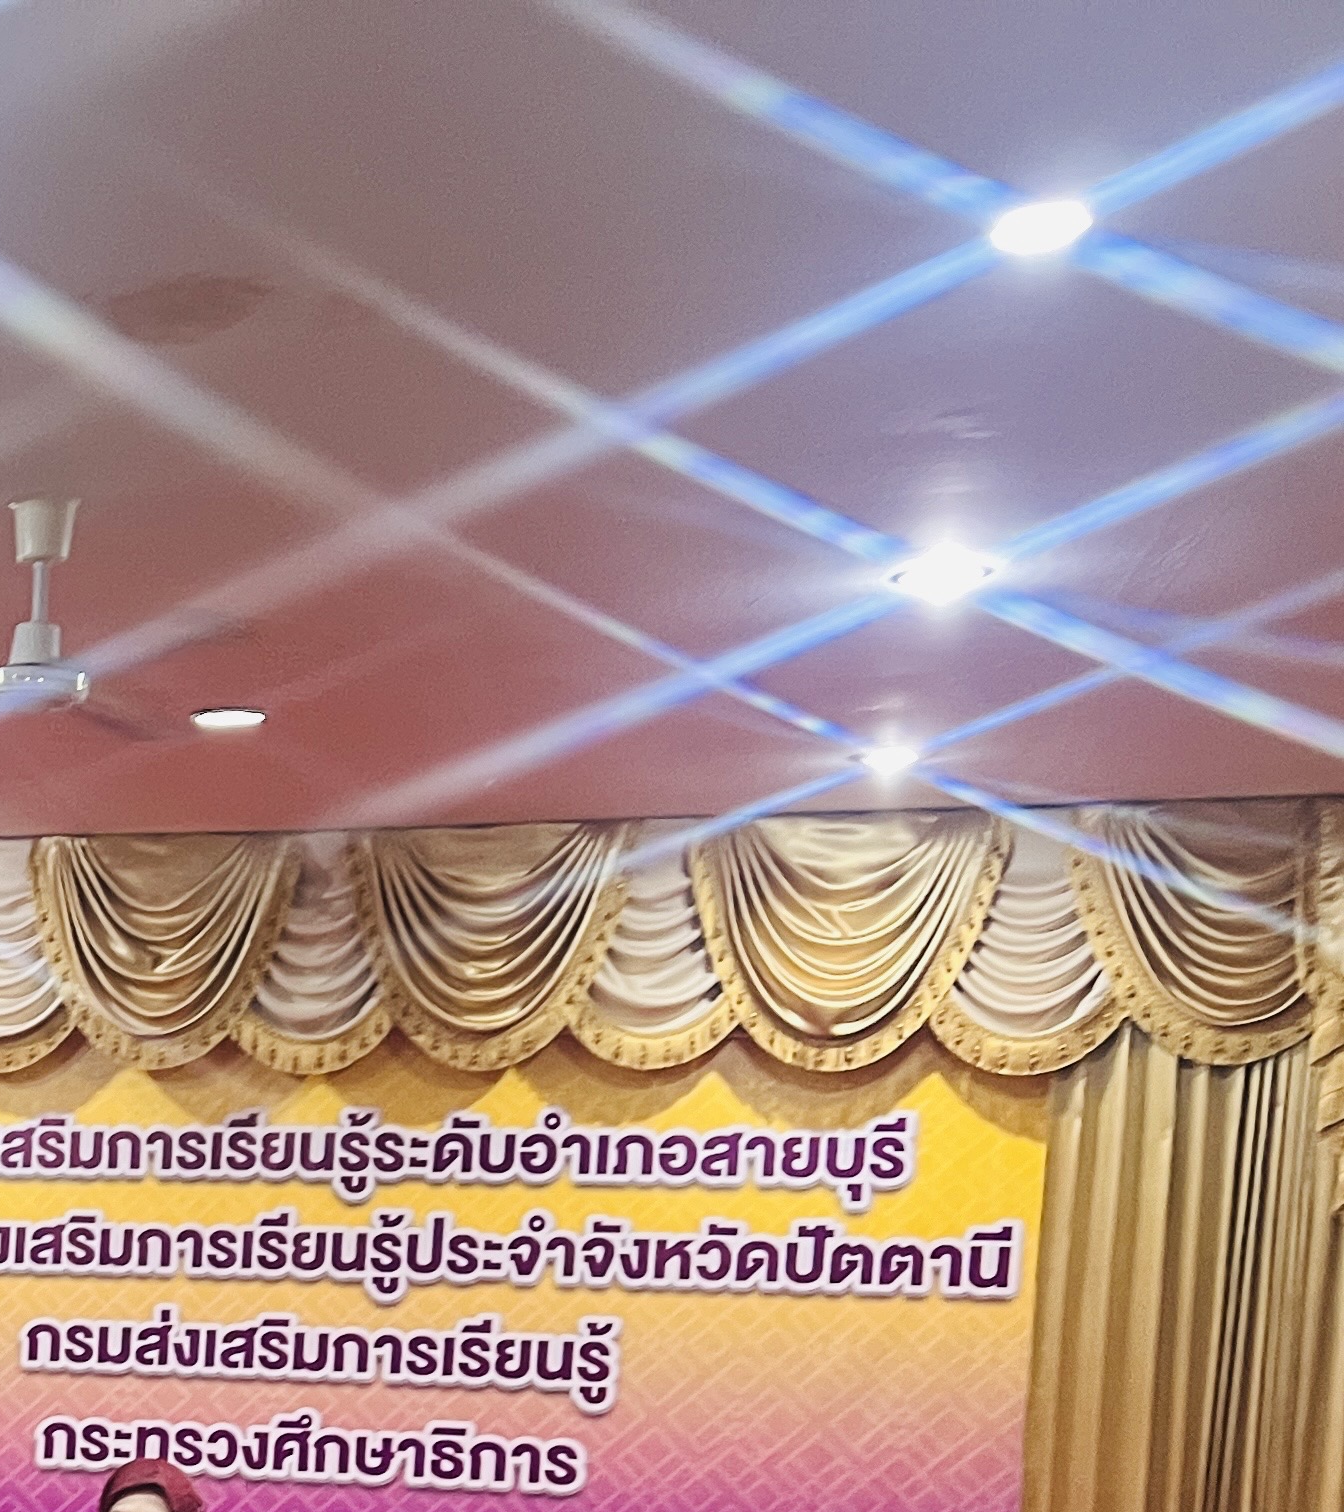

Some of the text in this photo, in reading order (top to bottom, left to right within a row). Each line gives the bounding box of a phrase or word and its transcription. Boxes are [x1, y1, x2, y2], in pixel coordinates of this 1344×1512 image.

[26, 1310, 613, 1404] กรมส่งเสริมการเรียนรู้
[42, 1414, 579, 1486] กระทรวงศึกษาธิการ
